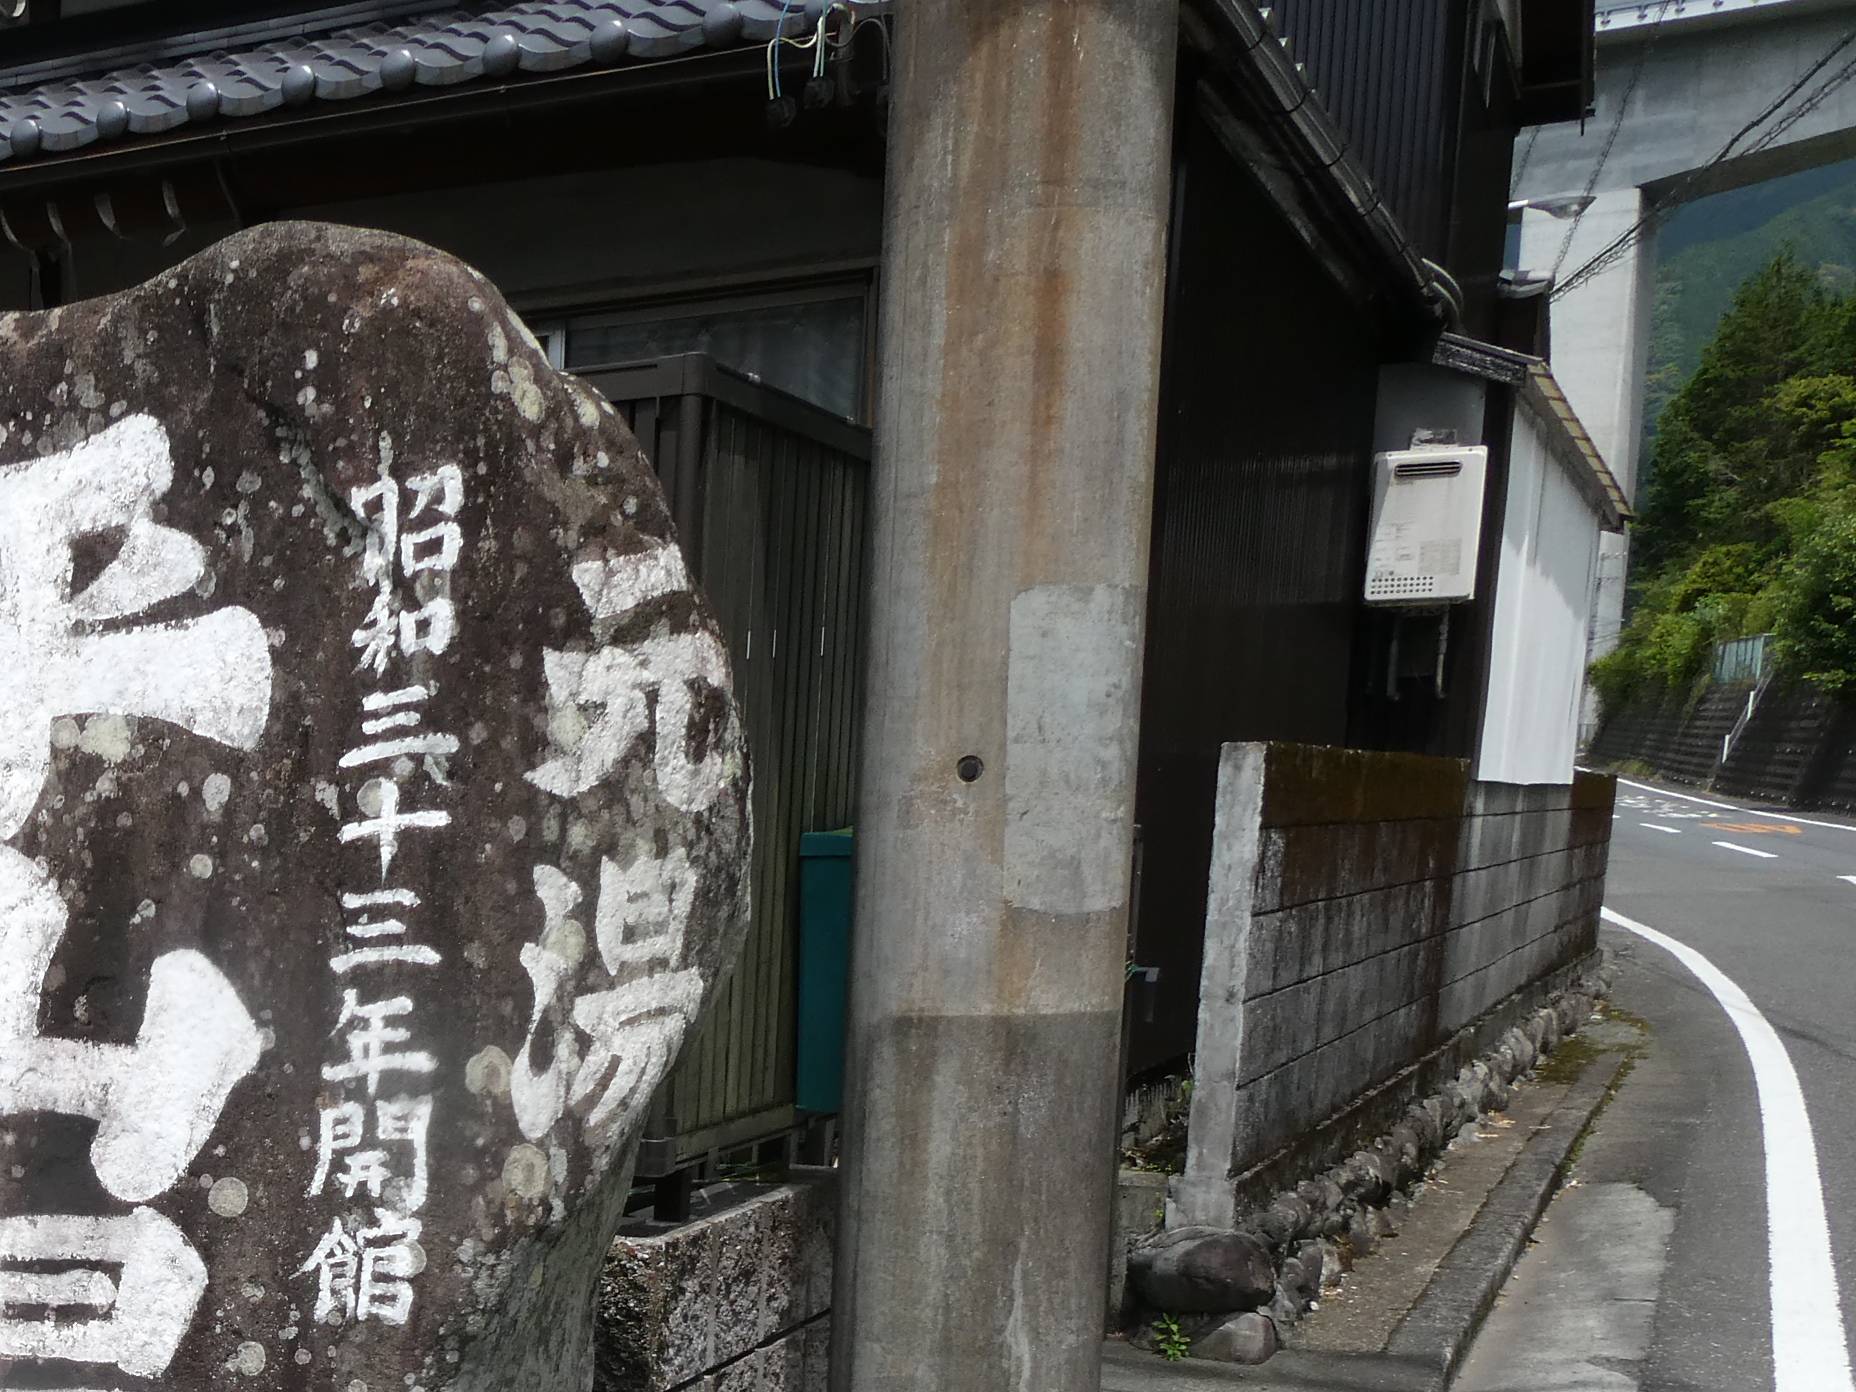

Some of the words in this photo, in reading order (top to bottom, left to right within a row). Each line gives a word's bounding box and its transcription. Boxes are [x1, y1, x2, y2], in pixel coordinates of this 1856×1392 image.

[290, 463, 466, 1326] 昭和三十三年開館
